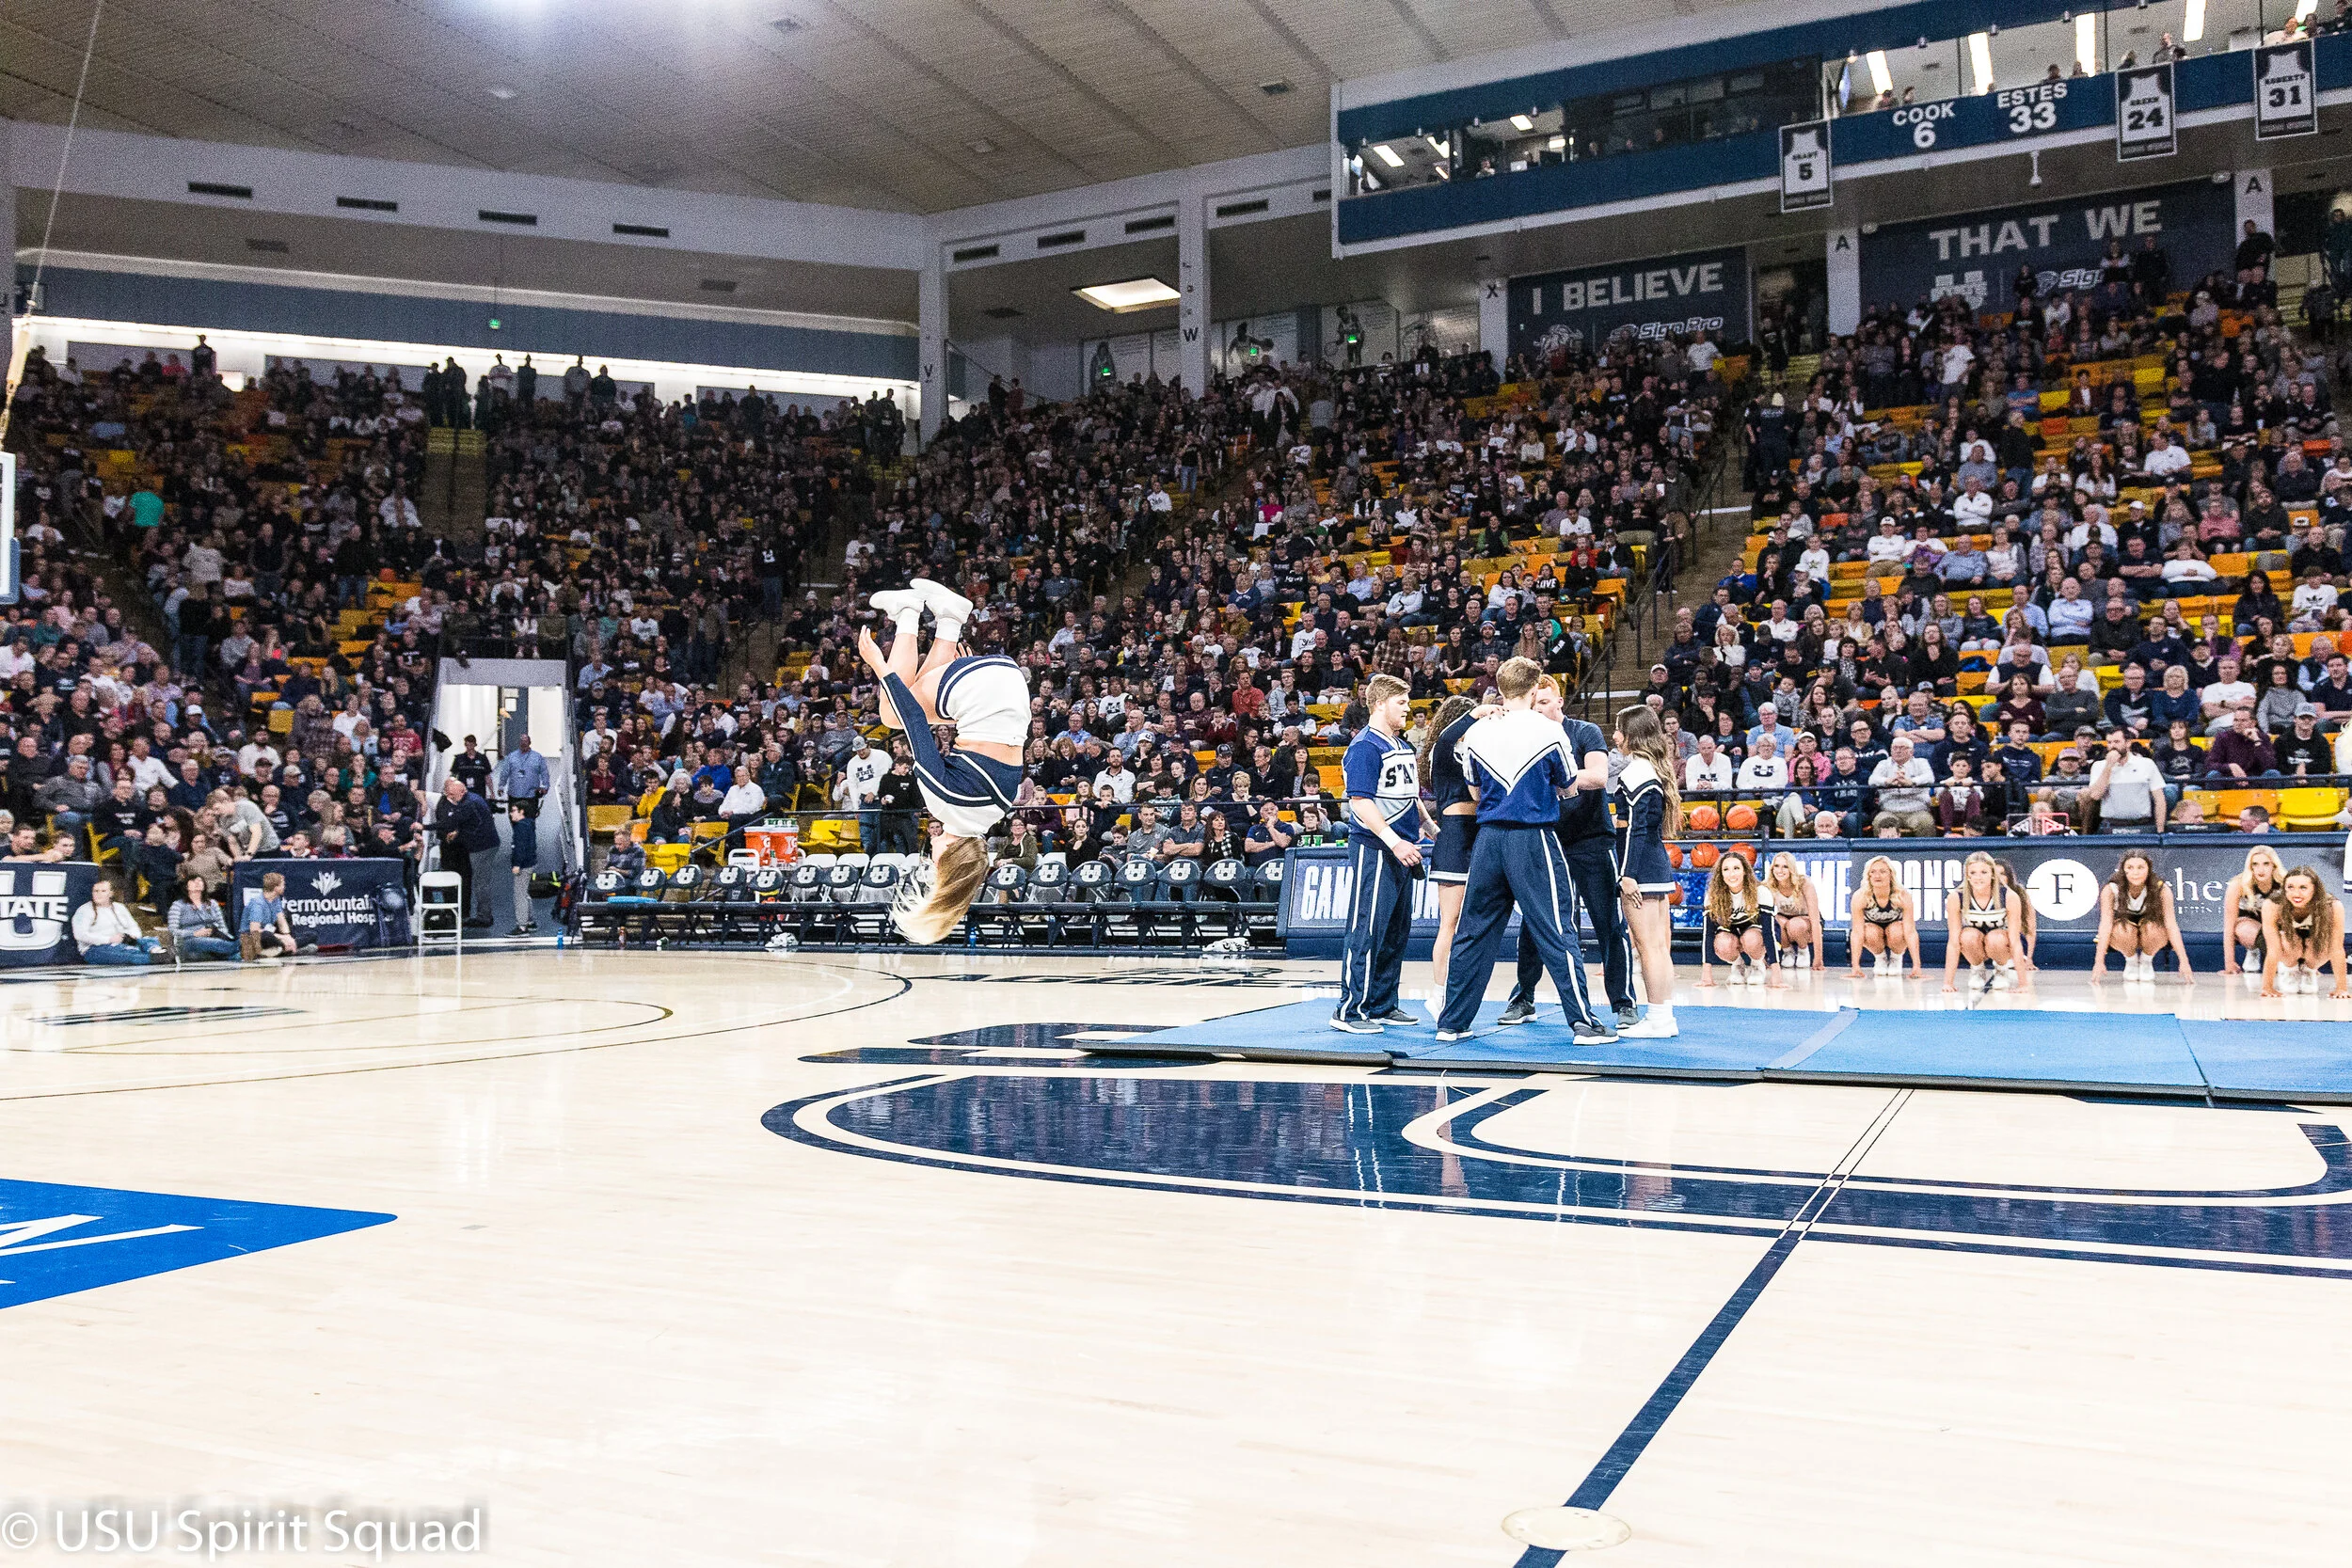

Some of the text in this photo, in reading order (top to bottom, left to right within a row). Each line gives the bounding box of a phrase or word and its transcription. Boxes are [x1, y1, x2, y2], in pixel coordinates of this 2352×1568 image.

[1996, 82, 2068, 109] ESTES
[2269, 86, 2301, 108] 31
[1892, 101, 1955, 126] COOK
[2010, 101, 2057, 134] 33
[2127, 106, 2164, 131] 24
[1914, 120, 1936, 149] 6
[1799, 162, 1813, 181] 5
[2246, 176, 2263, 196] A
[1835, 233, 1851, 251] A
[1929, 198, 2163, 261] THAT WE
[1486, 284, 1499, 299] X
[1533, 262, 1724, 316] I BELIEVE
[1184, 327, 1199, 342] W
[1687, 316, 1724, 334] Pro
[924, 363, 932, 377] V
[1300, 864, 1355, 921] GAM
[2051, 873, 2074, 905] F
[0, 895, 69, 922] TATE
[292, 911, 345, 928] Regional
